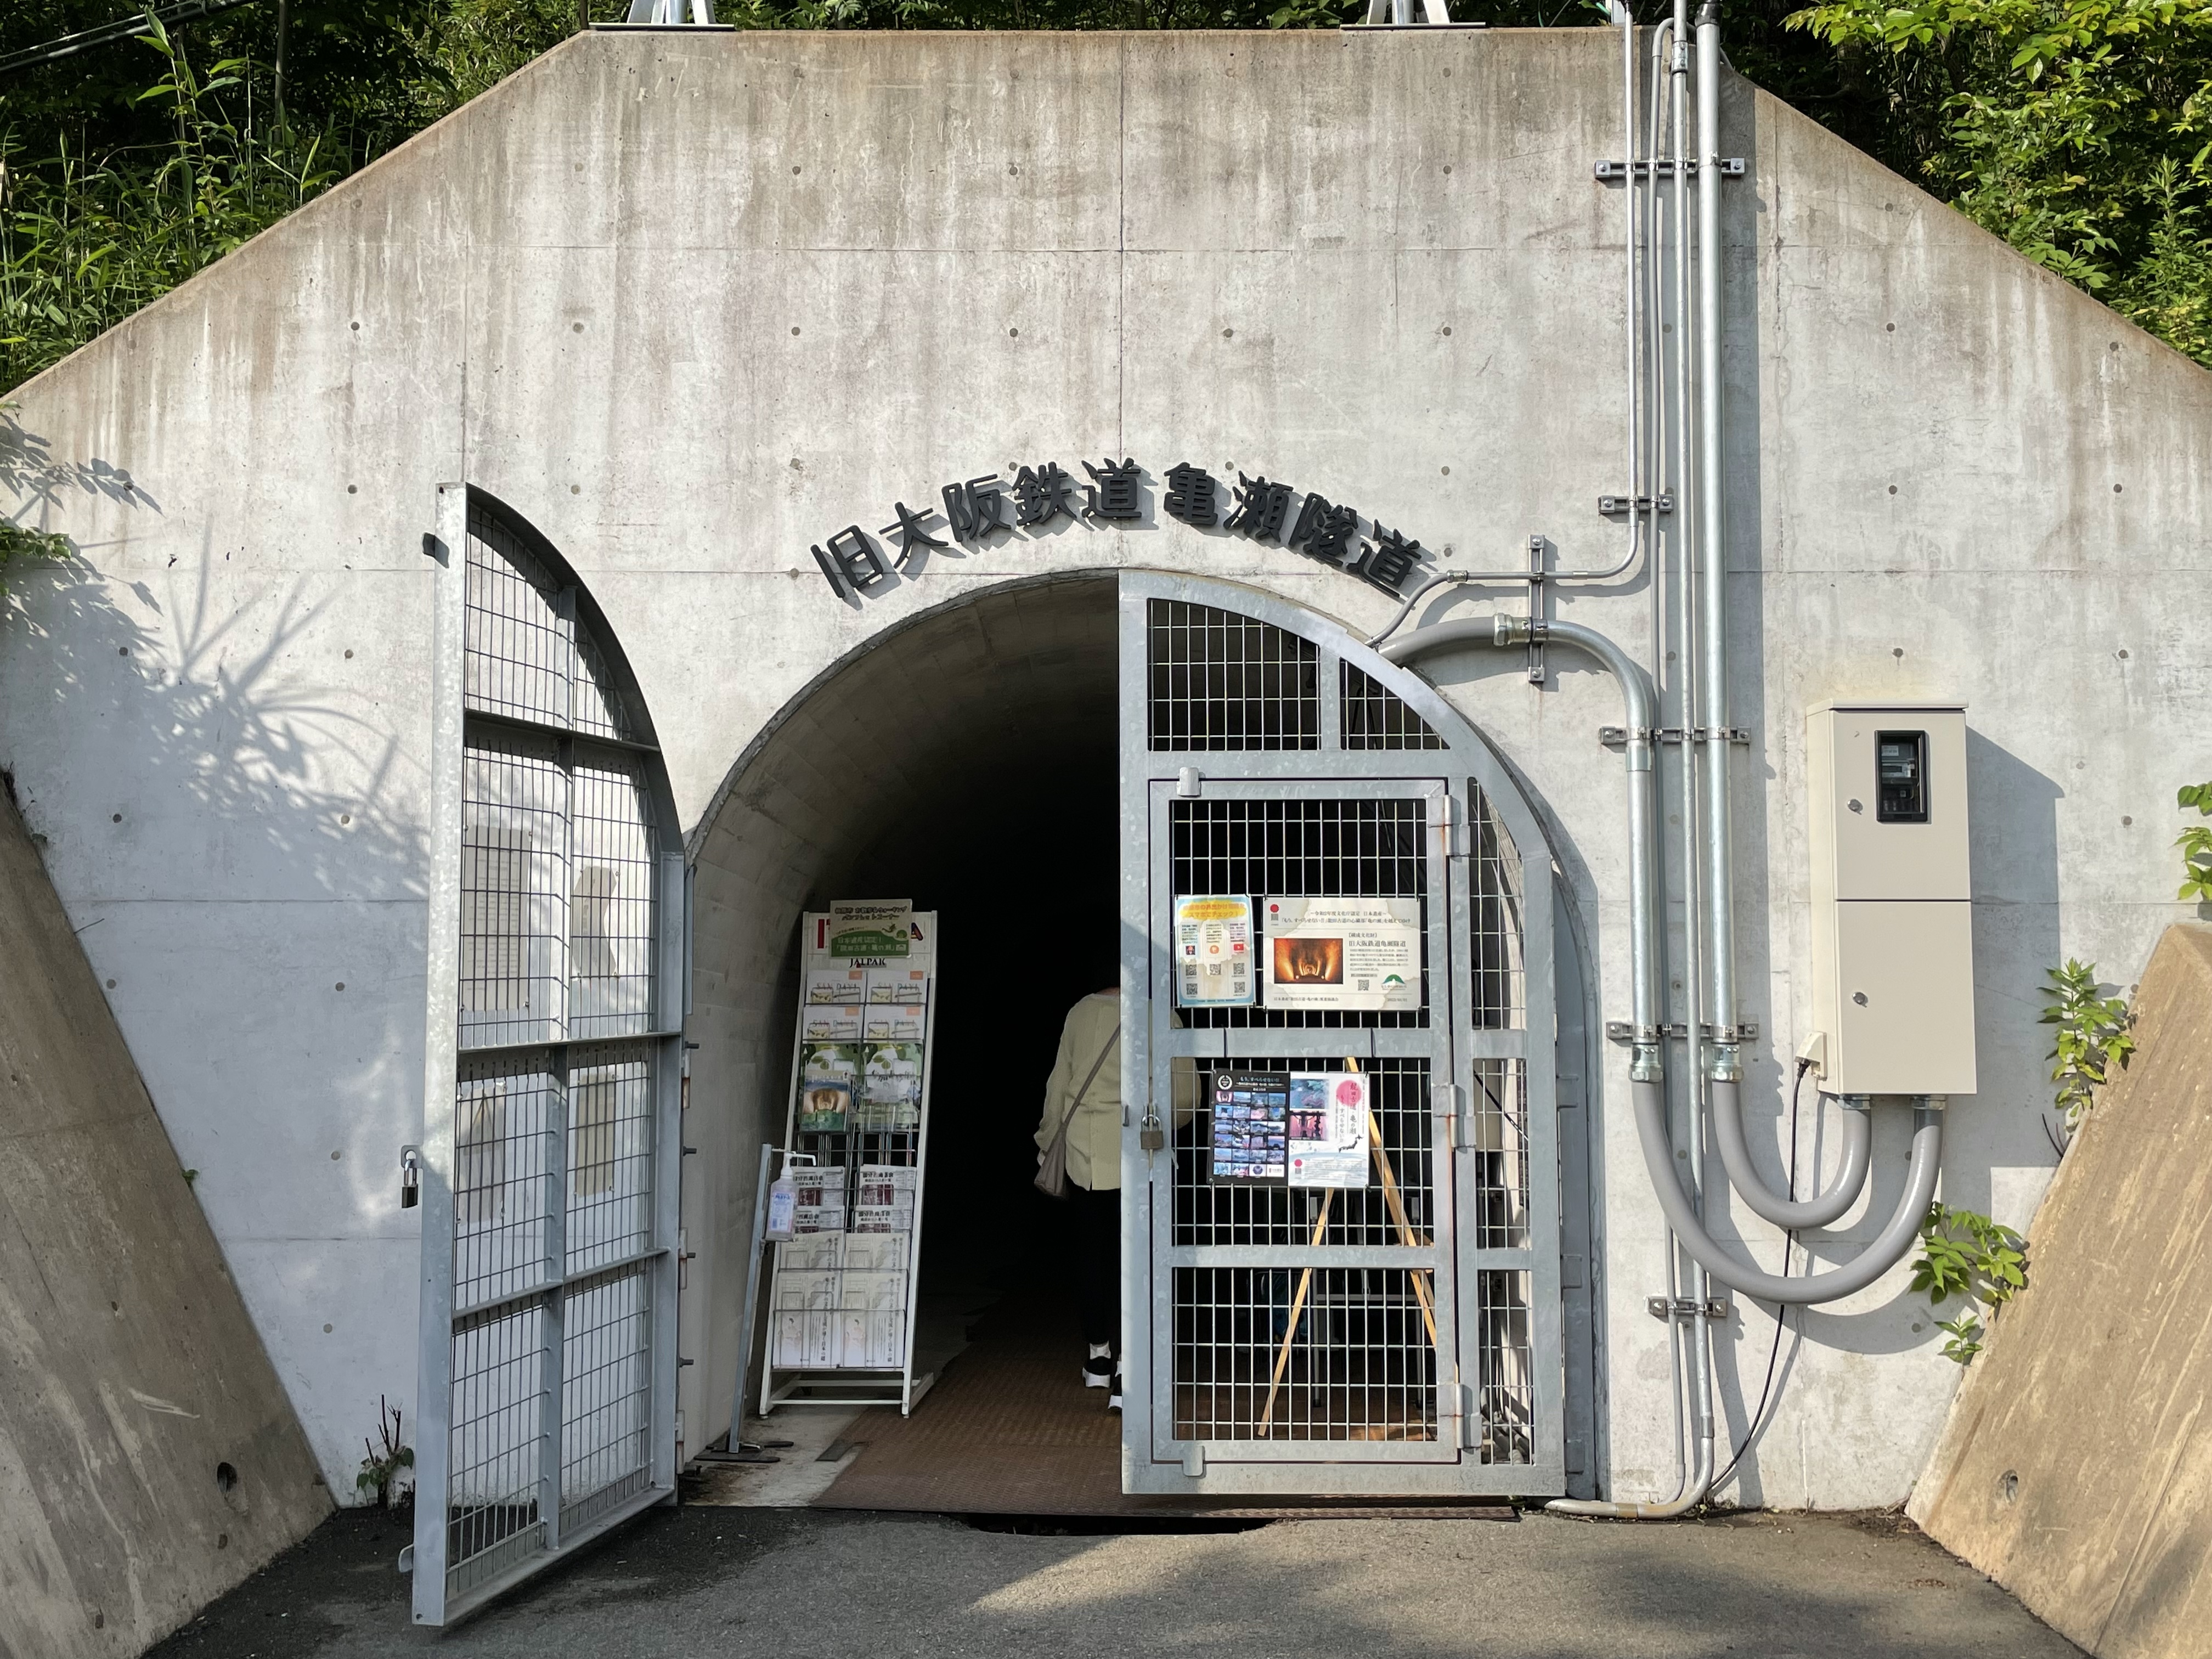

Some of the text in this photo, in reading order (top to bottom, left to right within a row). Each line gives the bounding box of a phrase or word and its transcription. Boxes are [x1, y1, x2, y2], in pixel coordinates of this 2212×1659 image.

[810, 458, 1423, 599] 旧大阪鉄道亀瀬隧道
[850, 958, 886, 968] JALPAK
